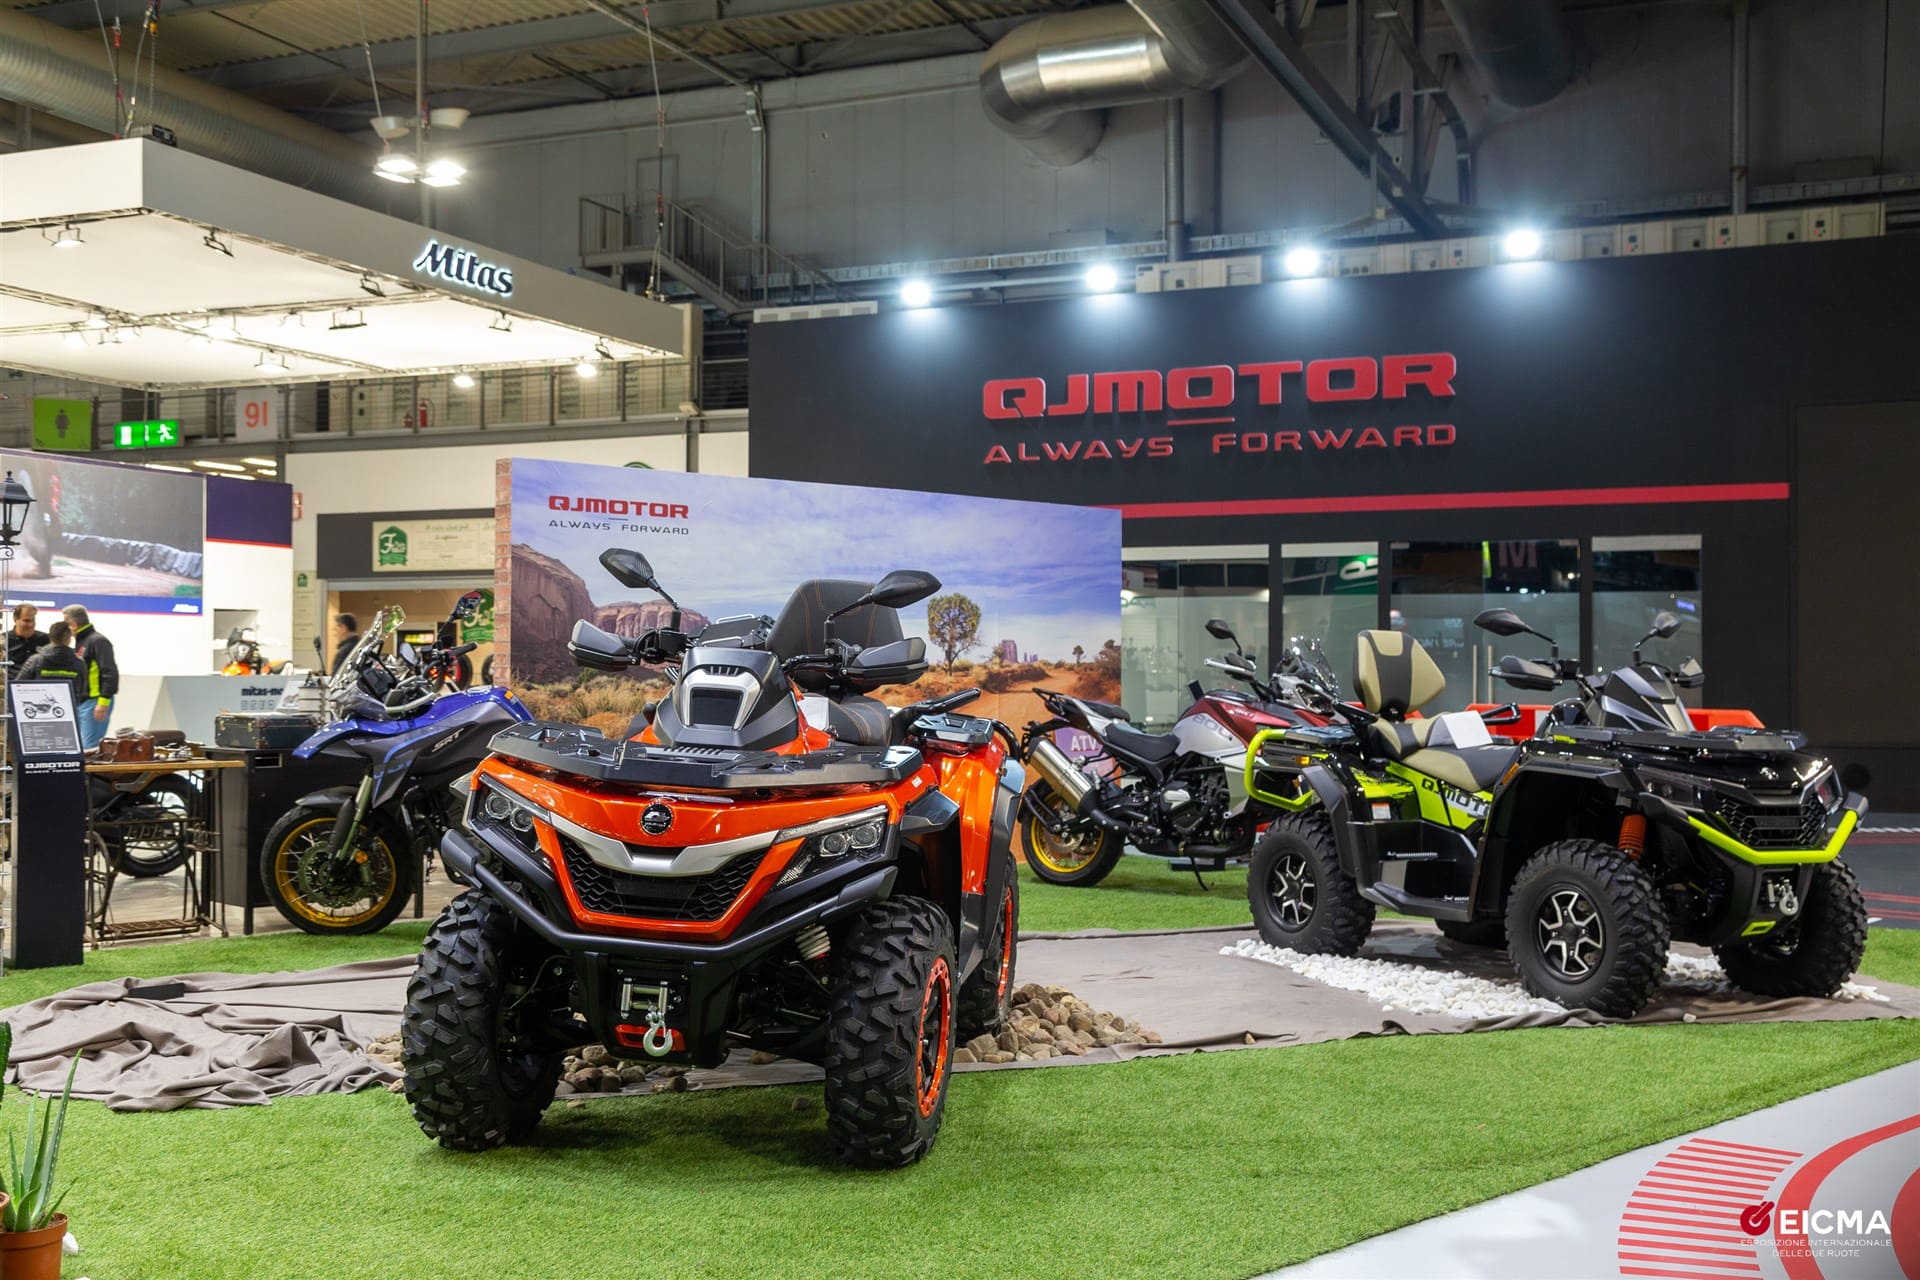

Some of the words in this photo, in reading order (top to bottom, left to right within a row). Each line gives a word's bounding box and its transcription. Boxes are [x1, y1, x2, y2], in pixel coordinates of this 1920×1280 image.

[414, 241, 513, 295] Mitas
[983, 352, 1457, 420] QJMOTOR
[984, 437, 1174, 465] ALWAYS
[1212, 424, 1457, 455] FORWARD
[548, 495, 689, 519] QJMOTOR
[549, 519, 611, 531] ALWAYS
[621, 523, 689, 535] FORWARD
[1071, 735, 1098, 751] ATV
